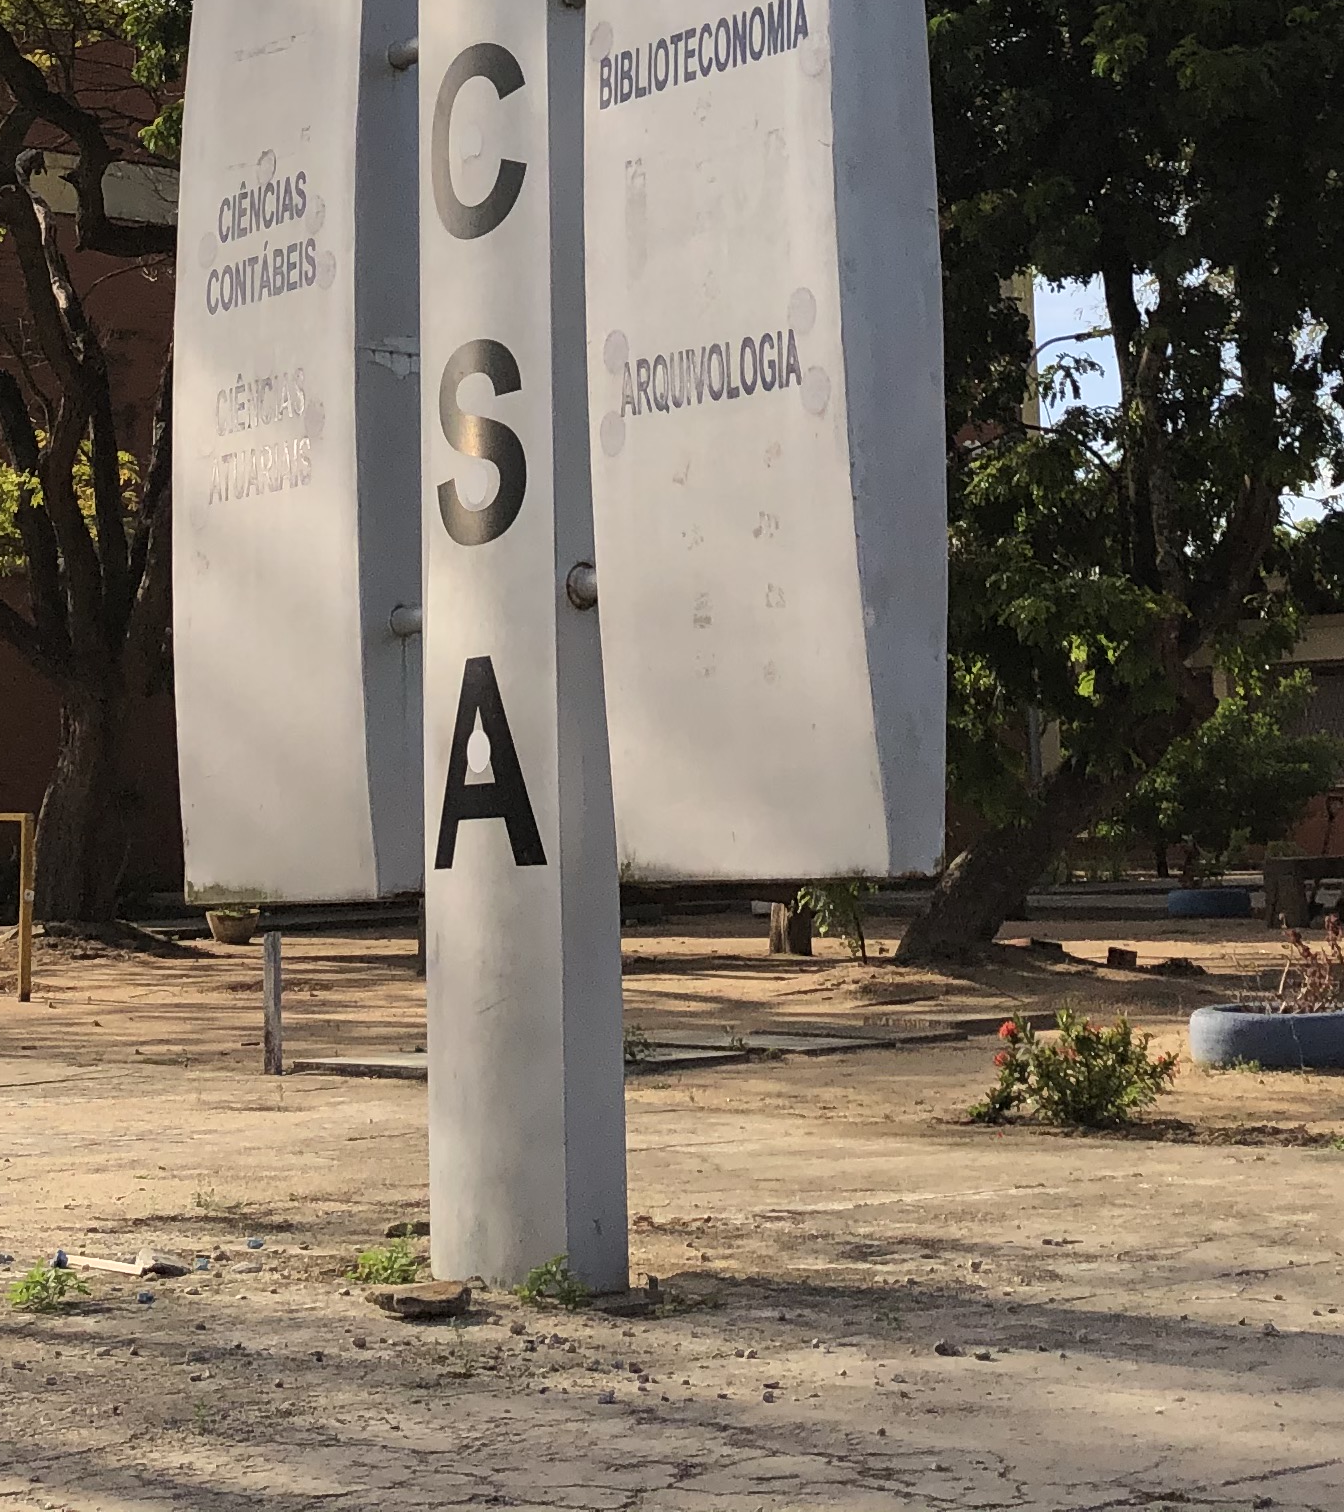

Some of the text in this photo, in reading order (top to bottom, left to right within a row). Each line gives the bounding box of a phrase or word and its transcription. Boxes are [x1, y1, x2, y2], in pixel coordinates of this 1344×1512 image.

[218, 170, 307, 244] CIÊNCIAS
[206, 237, 317, 315] CONTÁBEIS
[215, 367, 306, 438] CIÊNCIAS
[620, 328, 803, 418] ARQUIVOLOGIA
[208, 435, 312, 506] ATUARIAIS
